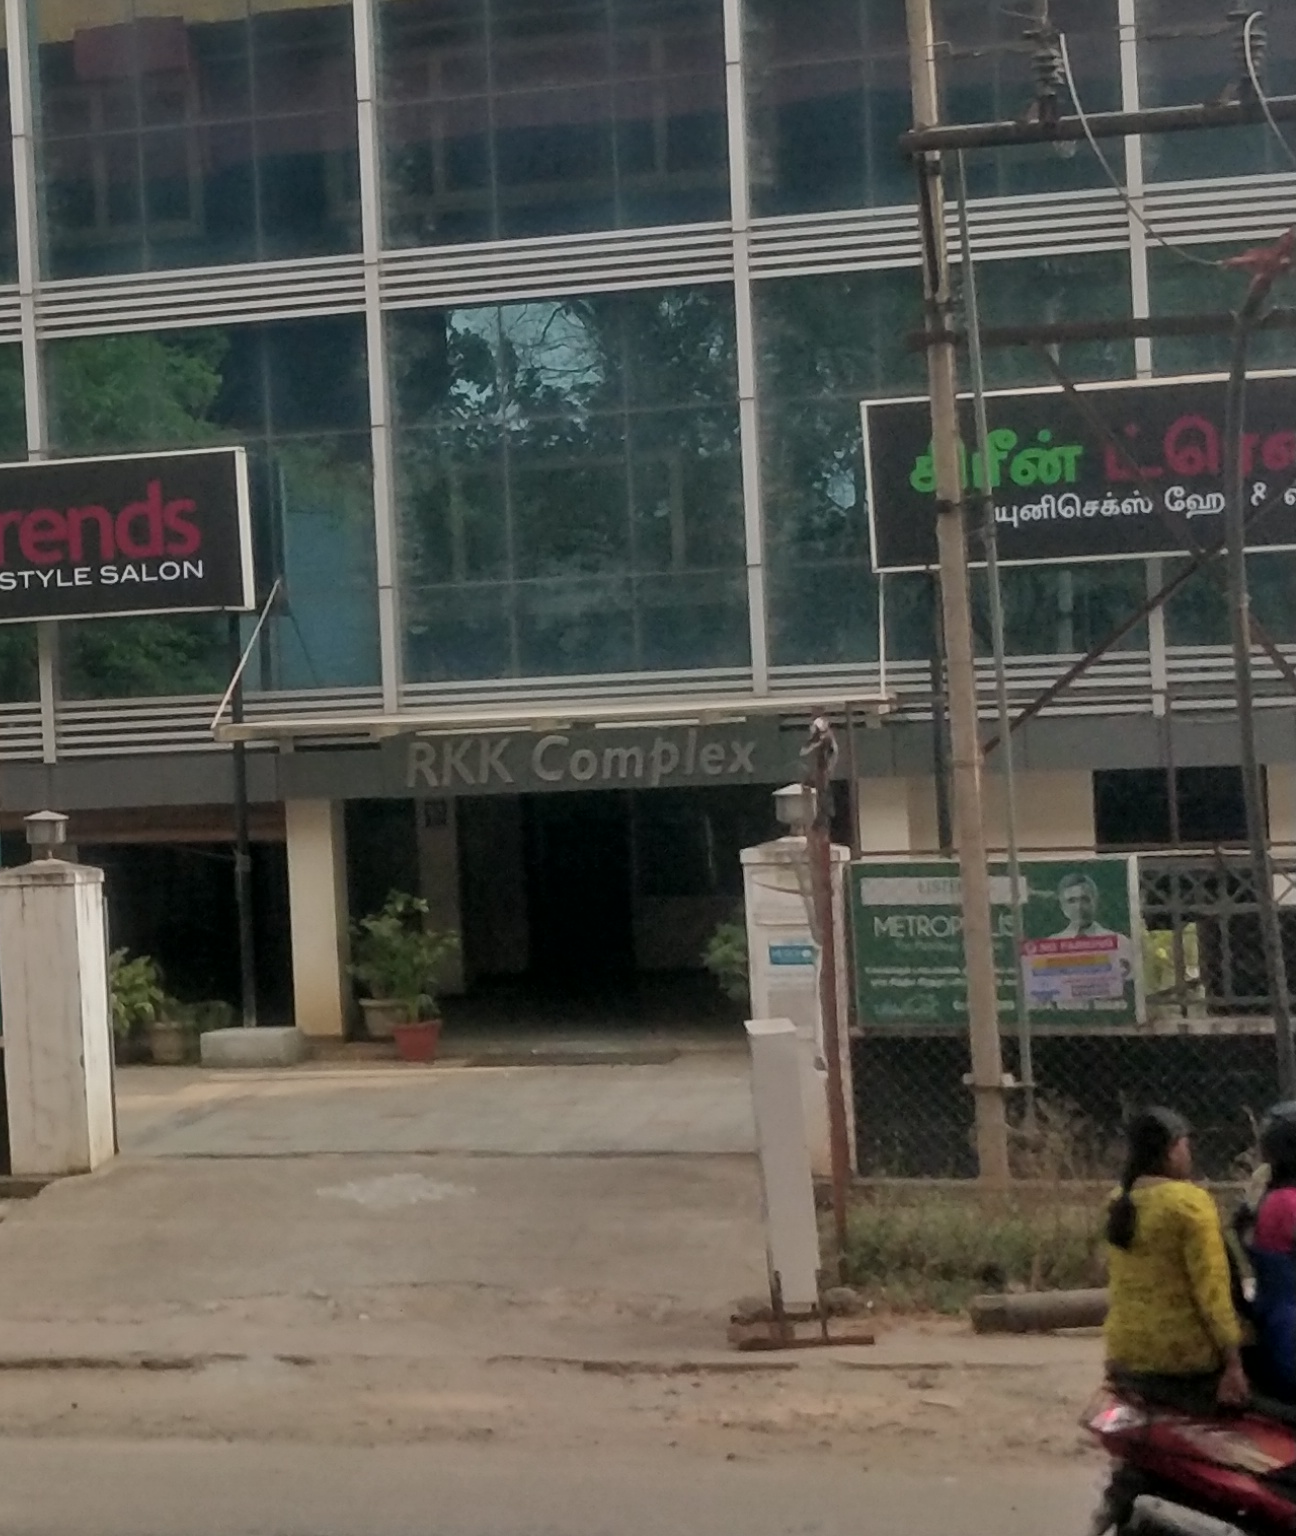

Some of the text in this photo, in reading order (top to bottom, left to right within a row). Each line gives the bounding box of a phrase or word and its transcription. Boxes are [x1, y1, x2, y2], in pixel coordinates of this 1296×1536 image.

[100, 560, 204, 585] SALON
[406, 728, 755, 789] RKK Complex
